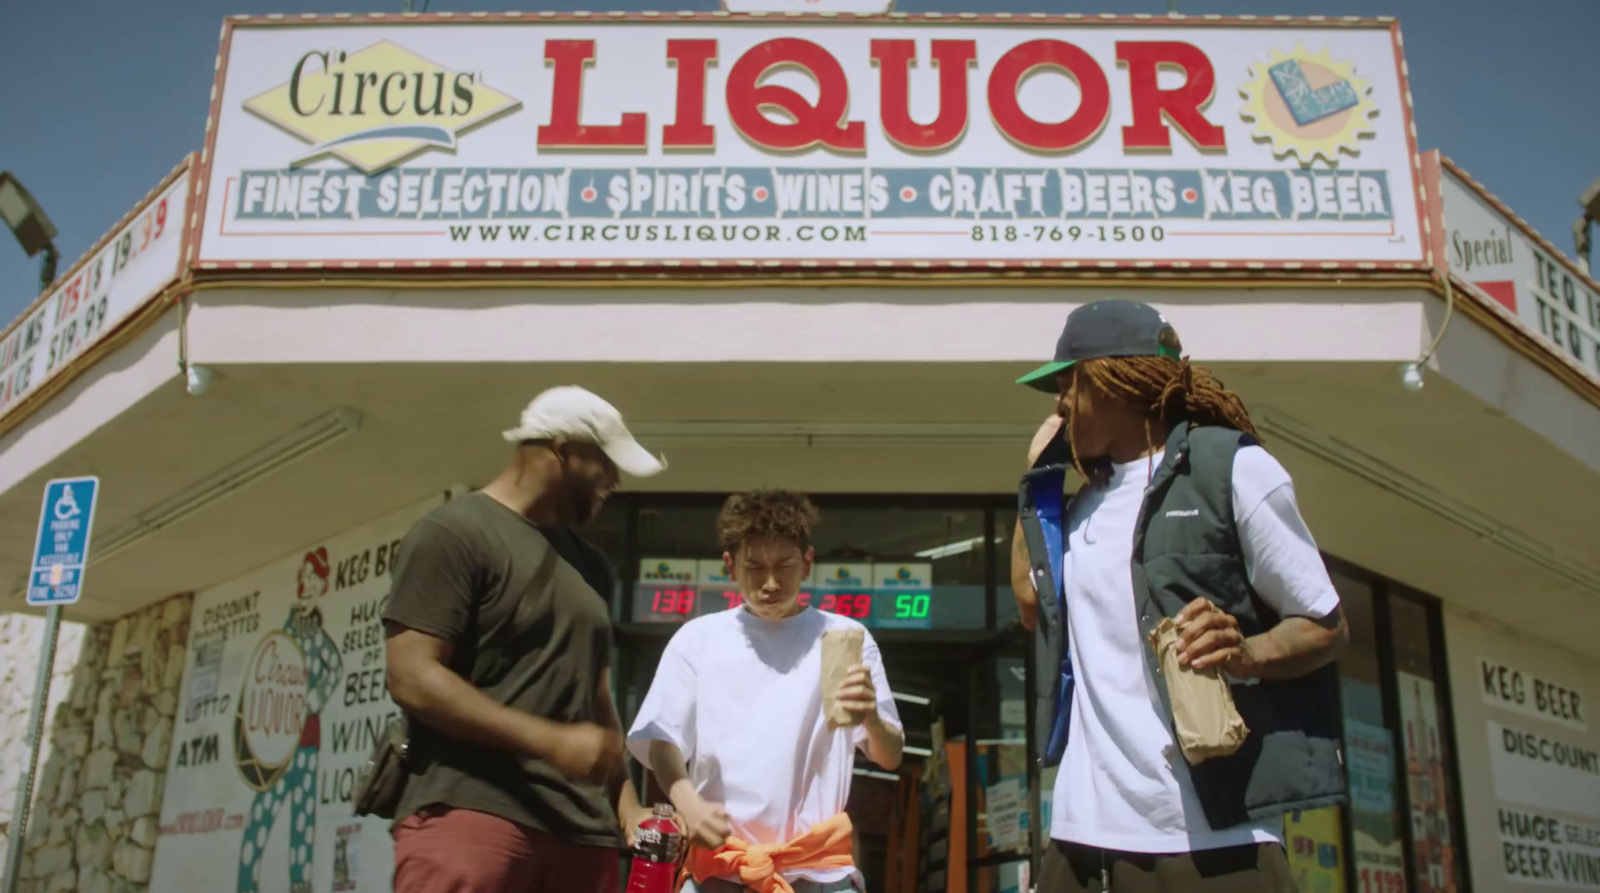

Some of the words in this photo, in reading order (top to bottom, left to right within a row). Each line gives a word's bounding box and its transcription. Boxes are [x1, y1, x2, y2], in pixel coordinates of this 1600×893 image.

[289, 49, 476, 118] Circus
[537, 37, 1226, 155] LIQUOR
[242, 171, 367, 215] FINEST
[376, 172, 568, 217] SELECTION
[605, 172, 746, 217] SPIRITS
[773, 172, 890, 217] WINES
[928, 172, 1049, 215] CRAFT
[1061, 172, 1177, 216] BEERS
[1203, 173, 1279, 217] KEG
[1290, 173, 1388, 217] BEER
[449, 225, 867, 242] WWW.CIRCUSLIQUOR.COM
[970, 226, 1166, 242] 818-769-1500
[1452, 226, 1514, 272] Special
[335, 550, 371, 591] KEG
[651, 590, 696, 614] 138
[819, 594, 872, 620] 269
[894, 594, 931, 618] 50
[1481, 660, 1526, 705] KEG
[1533, 679, 1584, 722] BEER
[175, 733, 220, 769] ATM
[1502, 728, 1600, 774] DISCOUNT
[1498, 808, 1562, 844] HUGE
[1502, 842, 1554, 879] BEER
